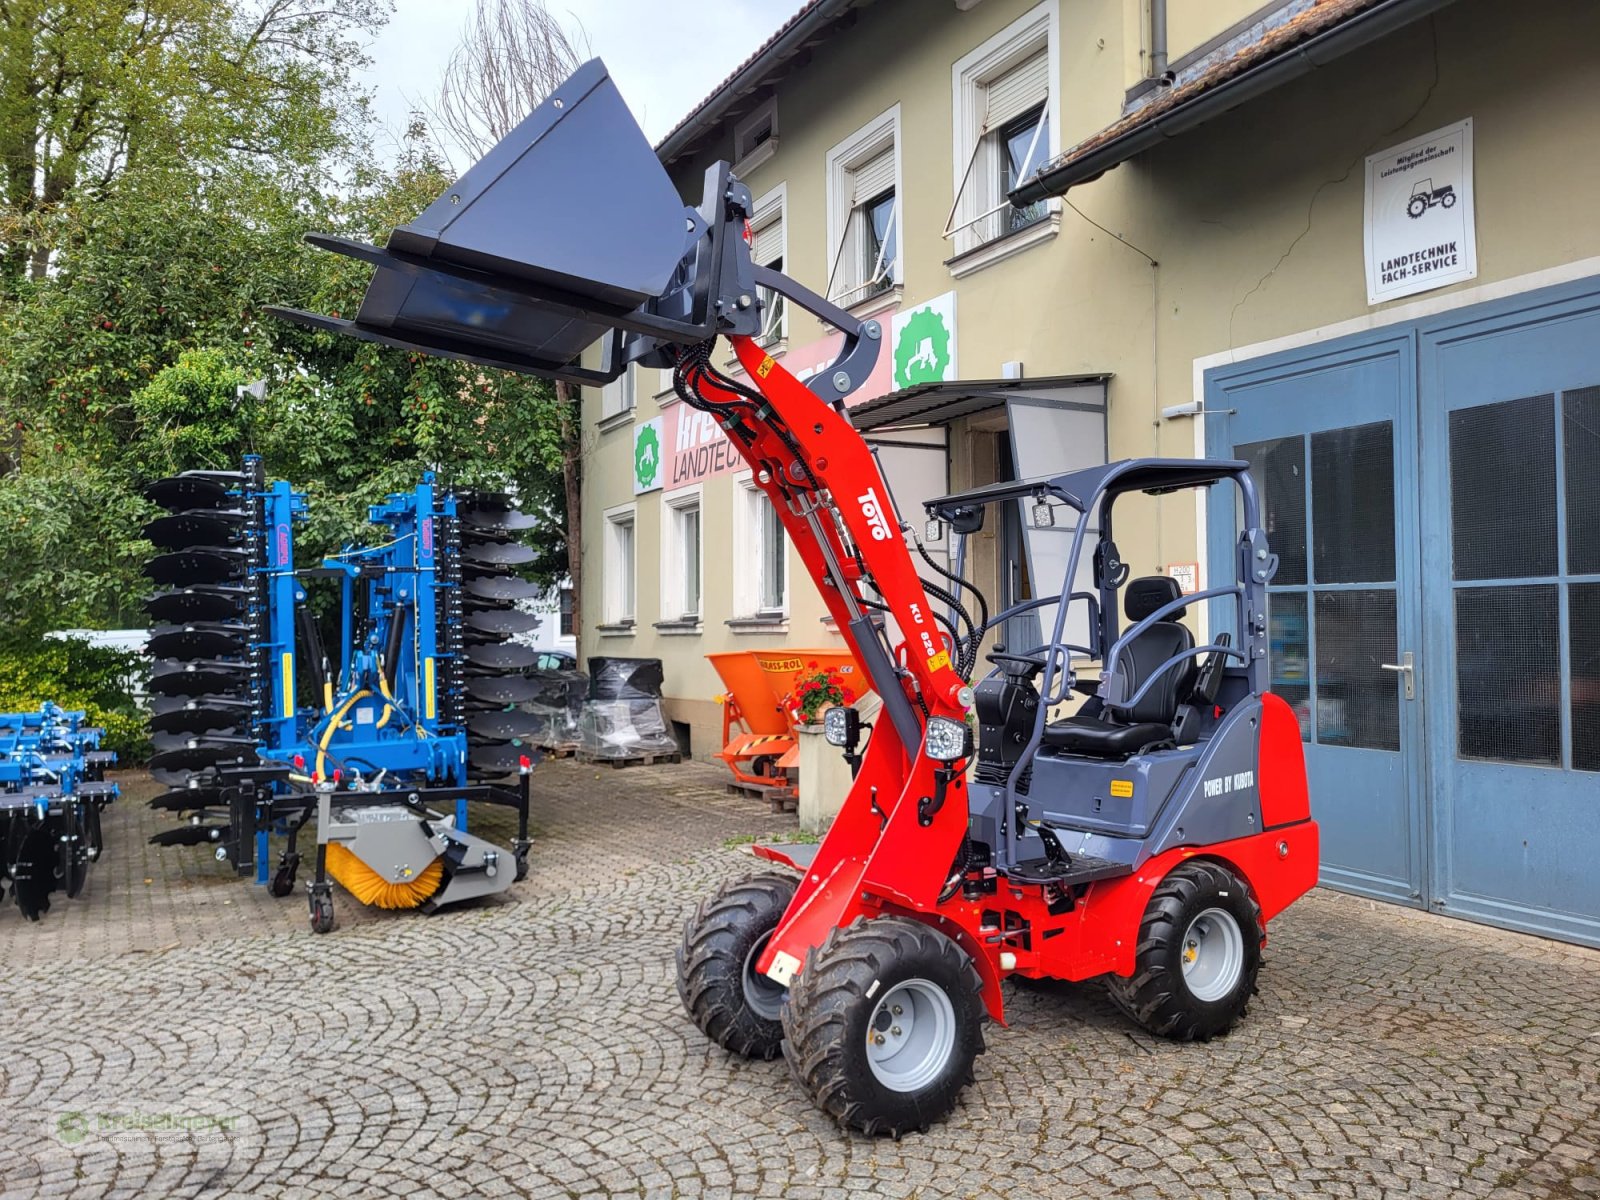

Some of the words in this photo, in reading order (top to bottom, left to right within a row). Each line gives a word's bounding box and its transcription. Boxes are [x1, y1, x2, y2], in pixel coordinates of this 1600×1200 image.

[1396, 149, 1424, 165] Mitglied
[1425, 146, 1437, 155] der
[1381, 241, 1457, 272] LANDTECHNIK
[1382, 254, 1457, 284] FACH-SERVICE
[857, 487, 893, 541] TOYO
[909, 603, 924, 624] KU
[920, 631, 936, 657] 826
[1203, 777, 1223, 798] POWER
[1224, 775, 1232, 793] BY
[1233, 770, 1254, 791] KUBOTA
